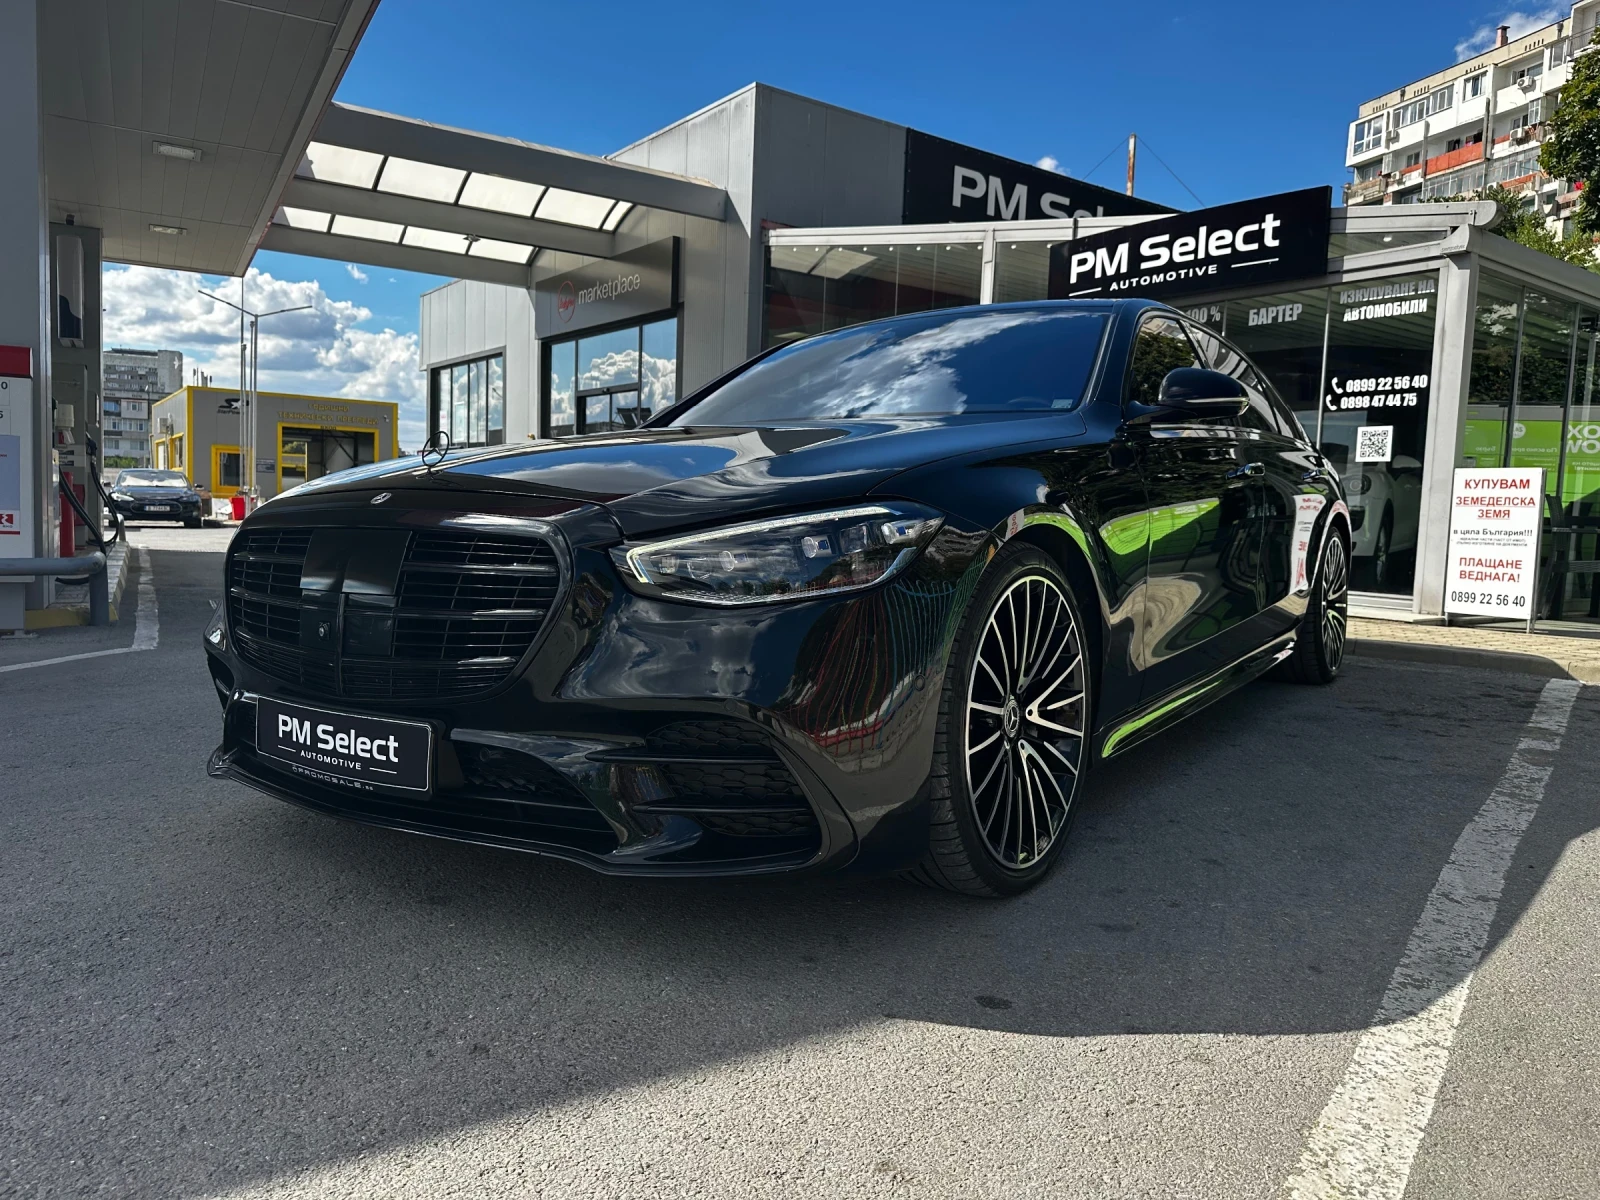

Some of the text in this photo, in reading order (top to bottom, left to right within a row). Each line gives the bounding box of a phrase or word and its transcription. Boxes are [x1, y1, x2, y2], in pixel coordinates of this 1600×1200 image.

[952, 165, 1028, 220] PM
[1069, 213, 1280, 284] PM Select
[1109, 264, 1218, 291] AUTOMOTIVE
[578, 273, 641, 304] marketplace
[1340, 279, 1436, 304] ИЗКУПУВАНЕ НА
[1248, 303, 1302, 326] БАРТЕР
[1343, 298, 1428, 322] АВТОМОБИЛИ
[1345, 374, 1428, 393] 0899 22 56 40
[1340, 392, 1417, 409] 0898 47 44 75
[278, 411, 334, 421] ТЕХНИЧЕСКИ
[1464, 479, 1530, 489] КУПУВАМ
[1455, 496, 1536, 507] ЗЕМЕДЕЛСКА
[1477, 509, 1510, 518] ЗЕМЯ
[1482, 528, 1533, 537] България!!!
[1459, 557, 1523, 569] ПЛАЩАНЕ
[1459, 570, 1520, 583] ВЕДНАГА!
[1451, 591, 1526, 607] 0899 22 56 40
[278, 714, 399, 763] PM Select
[300, 750, 362, 771] AUTOMOTIVE
